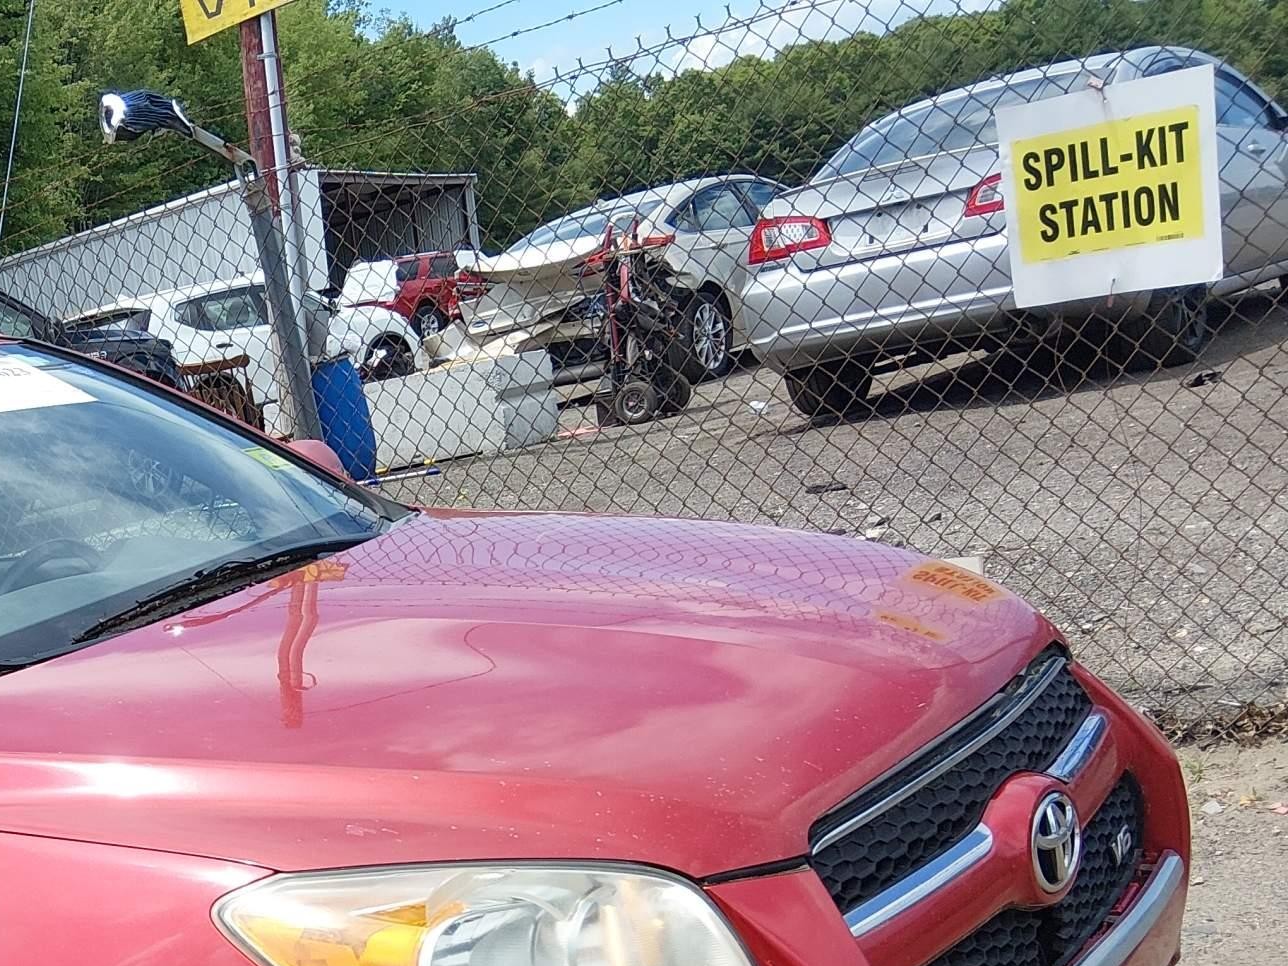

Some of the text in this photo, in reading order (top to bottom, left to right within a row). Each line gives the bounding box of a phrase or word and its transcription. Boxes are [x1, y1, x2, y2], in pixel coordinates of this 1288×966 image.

[1021, 121, 1189, 191] SPILL-KIT
[1039, 182, 1180, 243] STATION
[1112, 824, 1131, 866] V6
